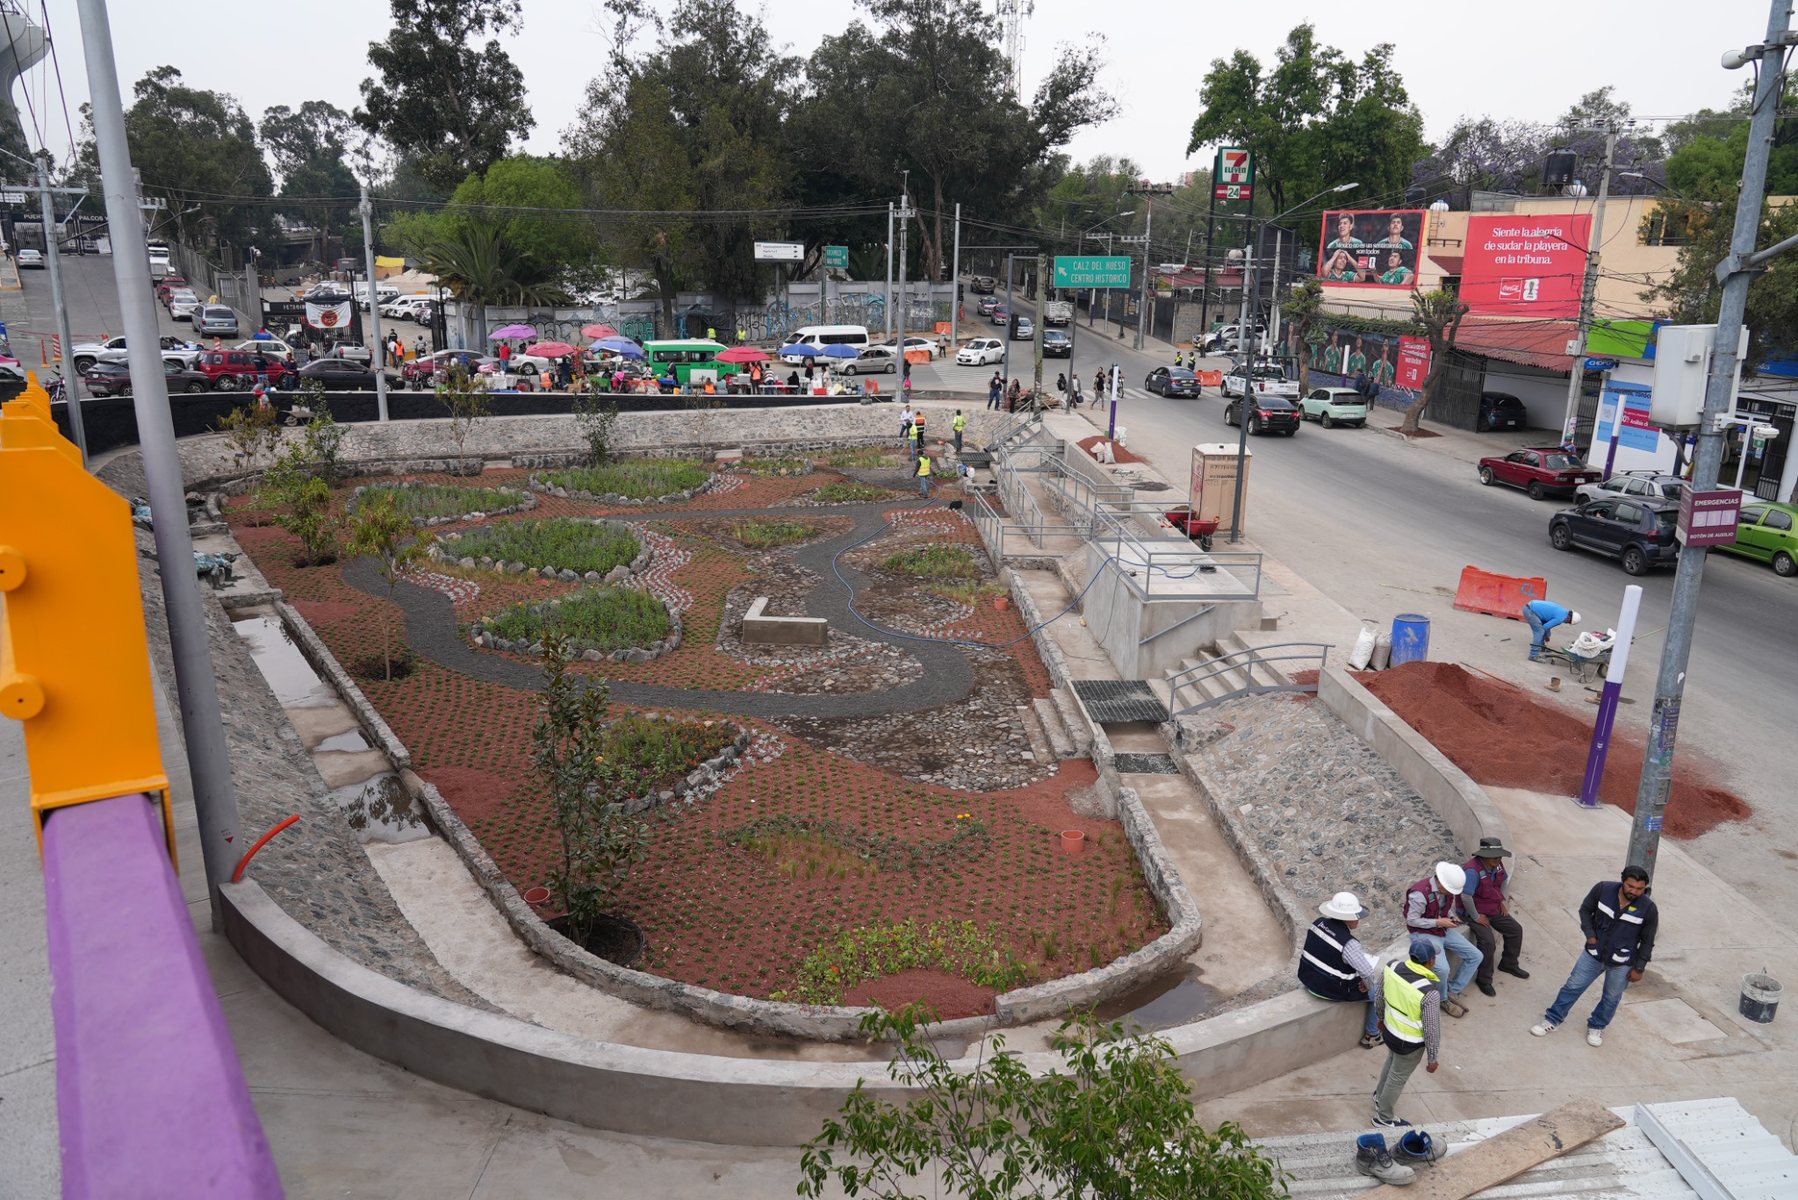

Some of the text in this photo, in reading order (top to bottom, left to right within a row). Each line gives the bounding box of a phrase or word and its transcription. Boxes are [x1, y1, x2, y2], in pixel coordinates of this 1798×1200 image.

[1226, 152, 1247, 182] 7
[1228, 187, 1239, 198] 24
[1492, 226, 1562, 239] Siente la alegría
[1484, 241, 1568, 252] de sudar la playera
[1495, 254, 1552, 264] en la tribuna.
[1091, 261, 1102, 270] DEL
[1070, 274, 1094, 283] CENTRO
[1694, 498, 1739, 506] EMERGENCIAS
